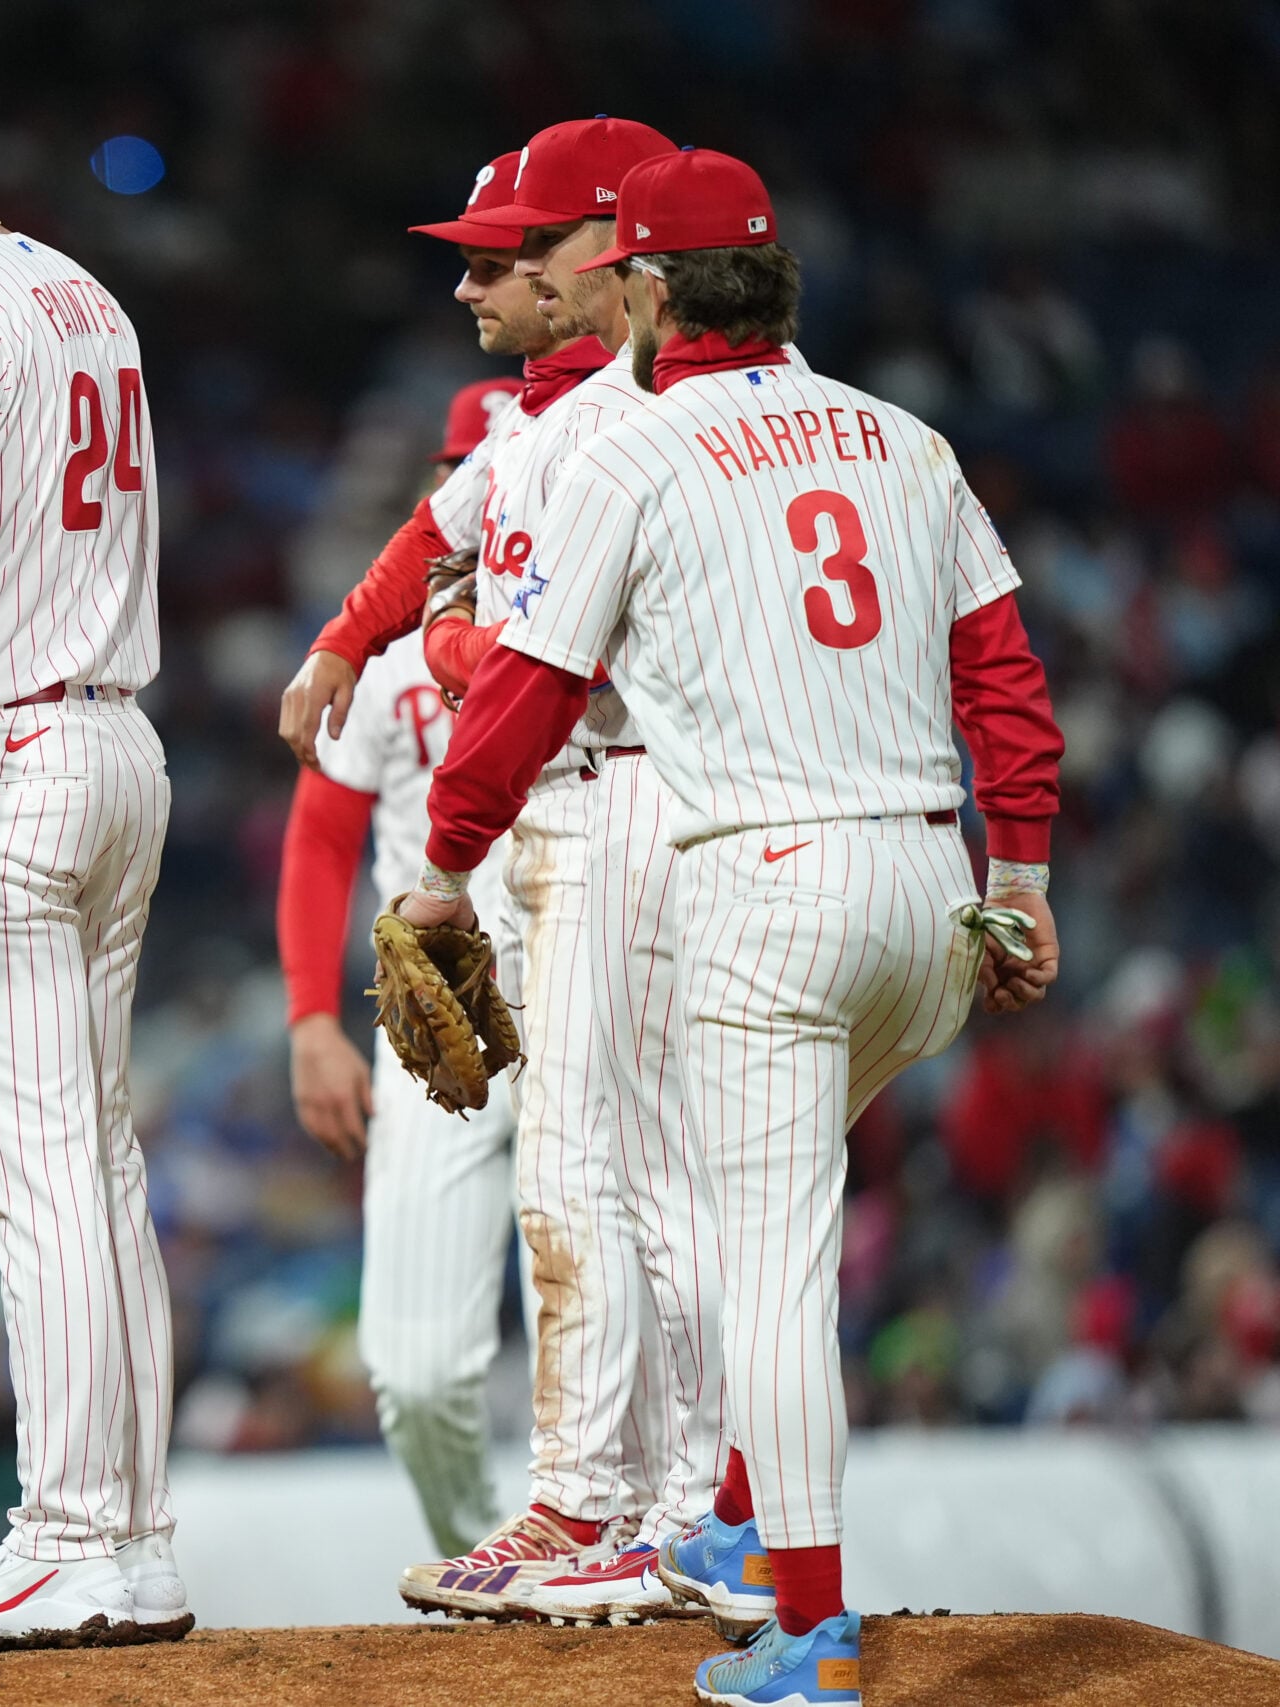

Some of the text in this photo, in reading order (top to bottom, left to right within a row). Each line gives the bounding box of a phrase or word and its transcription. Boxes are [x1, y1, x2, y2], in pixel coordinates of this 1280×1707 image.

[31, 280, 129, 343] PAINTER
[62, 368, 142, 532] 24
[695, 408, 887, 481] HARPER
[786, 489, 882, 649] 3
